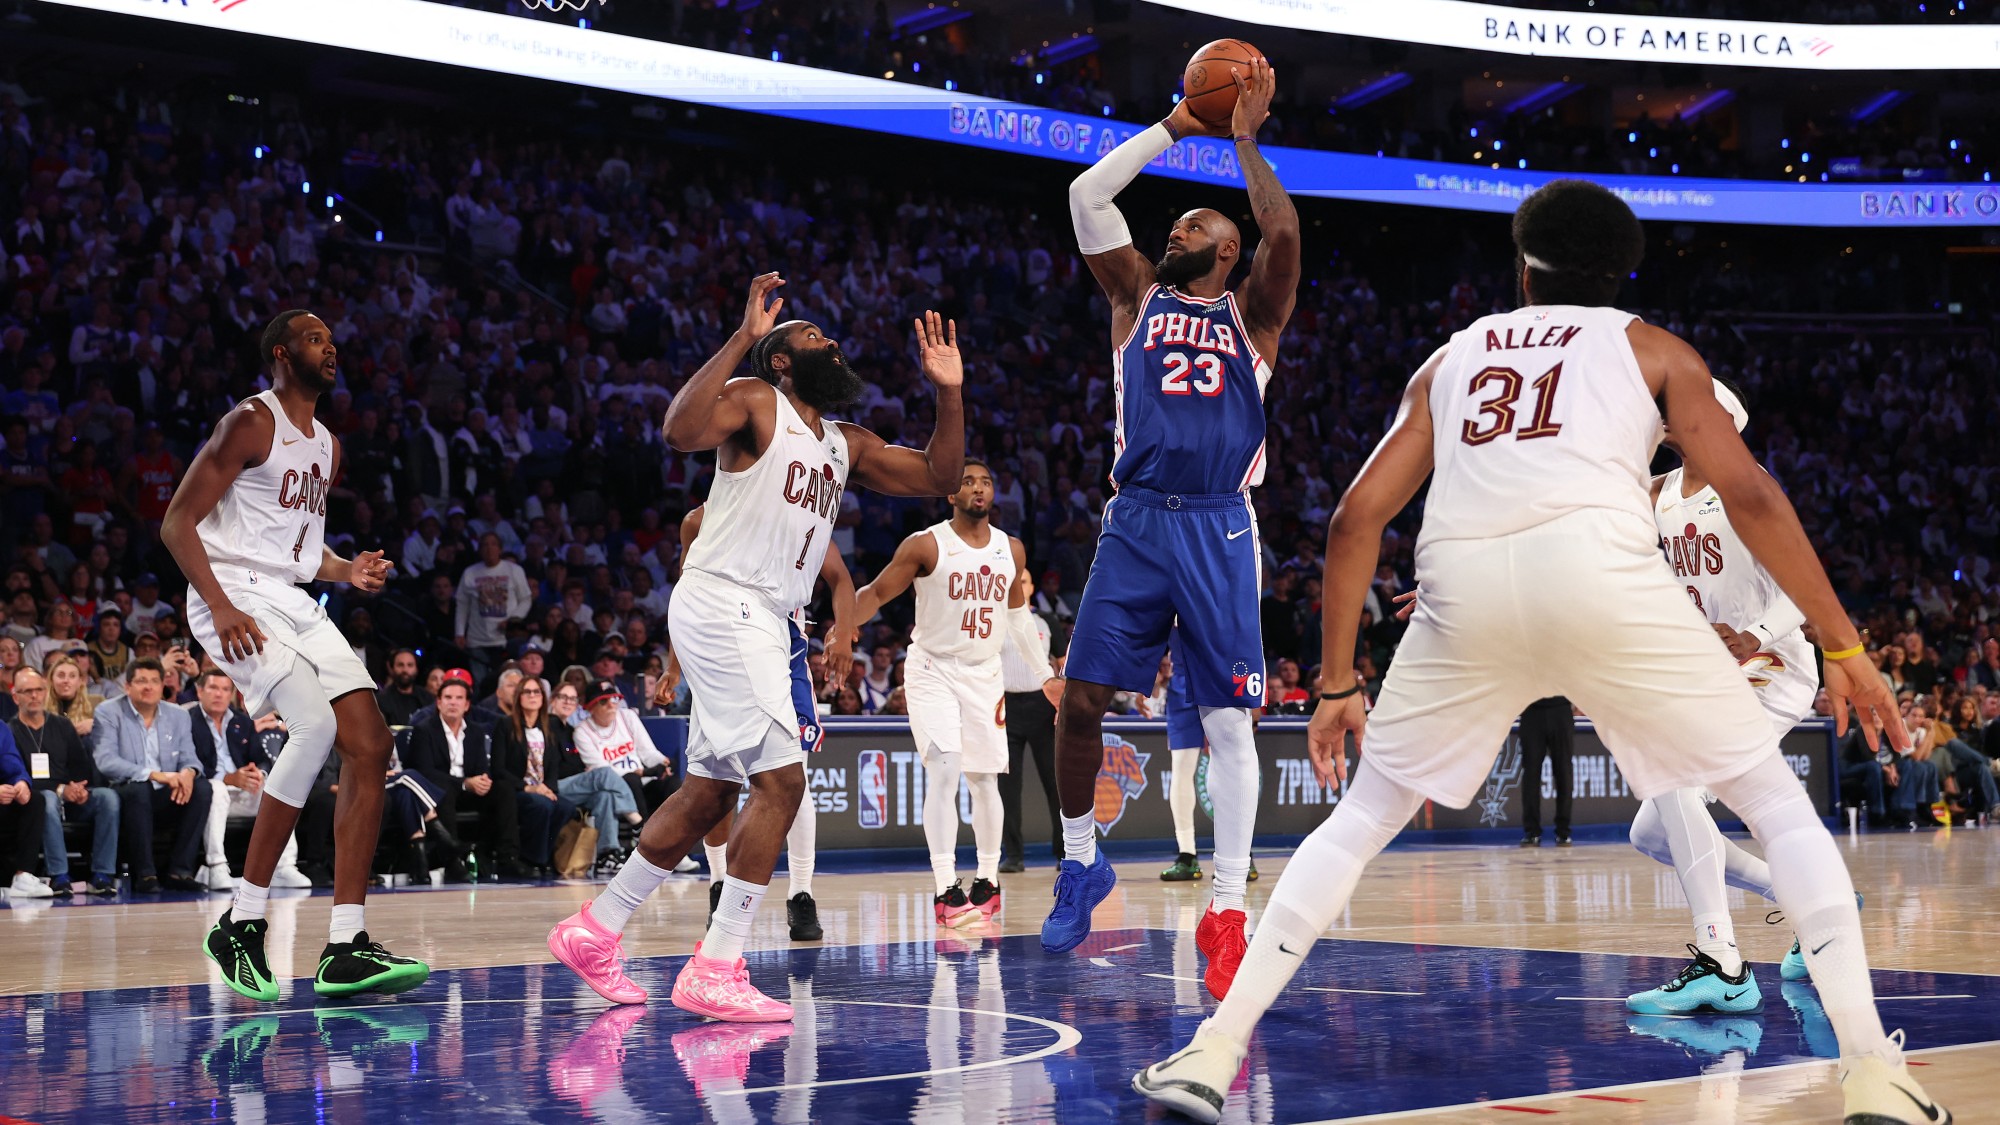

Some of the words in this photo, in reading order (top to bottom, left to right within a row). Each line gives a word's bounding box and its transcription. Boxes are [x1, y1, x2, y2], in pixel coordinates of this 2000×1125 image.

[1486, 17, 1571, 45] BANK
[1587, 26, 1626, 48] OF
[1640, 29, 1792, 57] AMERICA
[949, 102, 1043, 147] BANK
[1049, 119, 1092, 153] OF
[1096, 128, 1238, 179] ARICA
[1860, 191, 1967, 218] BANK
[1144, 313, 1239, 358] PHILA
[1486, 325, 1582, 352] ALLEN
[1161, 352, 1225, 397] 23
[1461, 360, 1564, 447] 31
[278, 468, 330, 517] CAVS
[784, 461, 842, 525] CAVS
[1698, 506, 1720, 515] CLIFFS
[292, 521, 310, 563] 4
[795, 525, 817, 571] 1
[949, 571, 1007, 602] CAVS
[961, 607, 993, 639] 45
[1232, 672, 1262, 697] 76
[1276, 759, 1322, 806] 7PM
